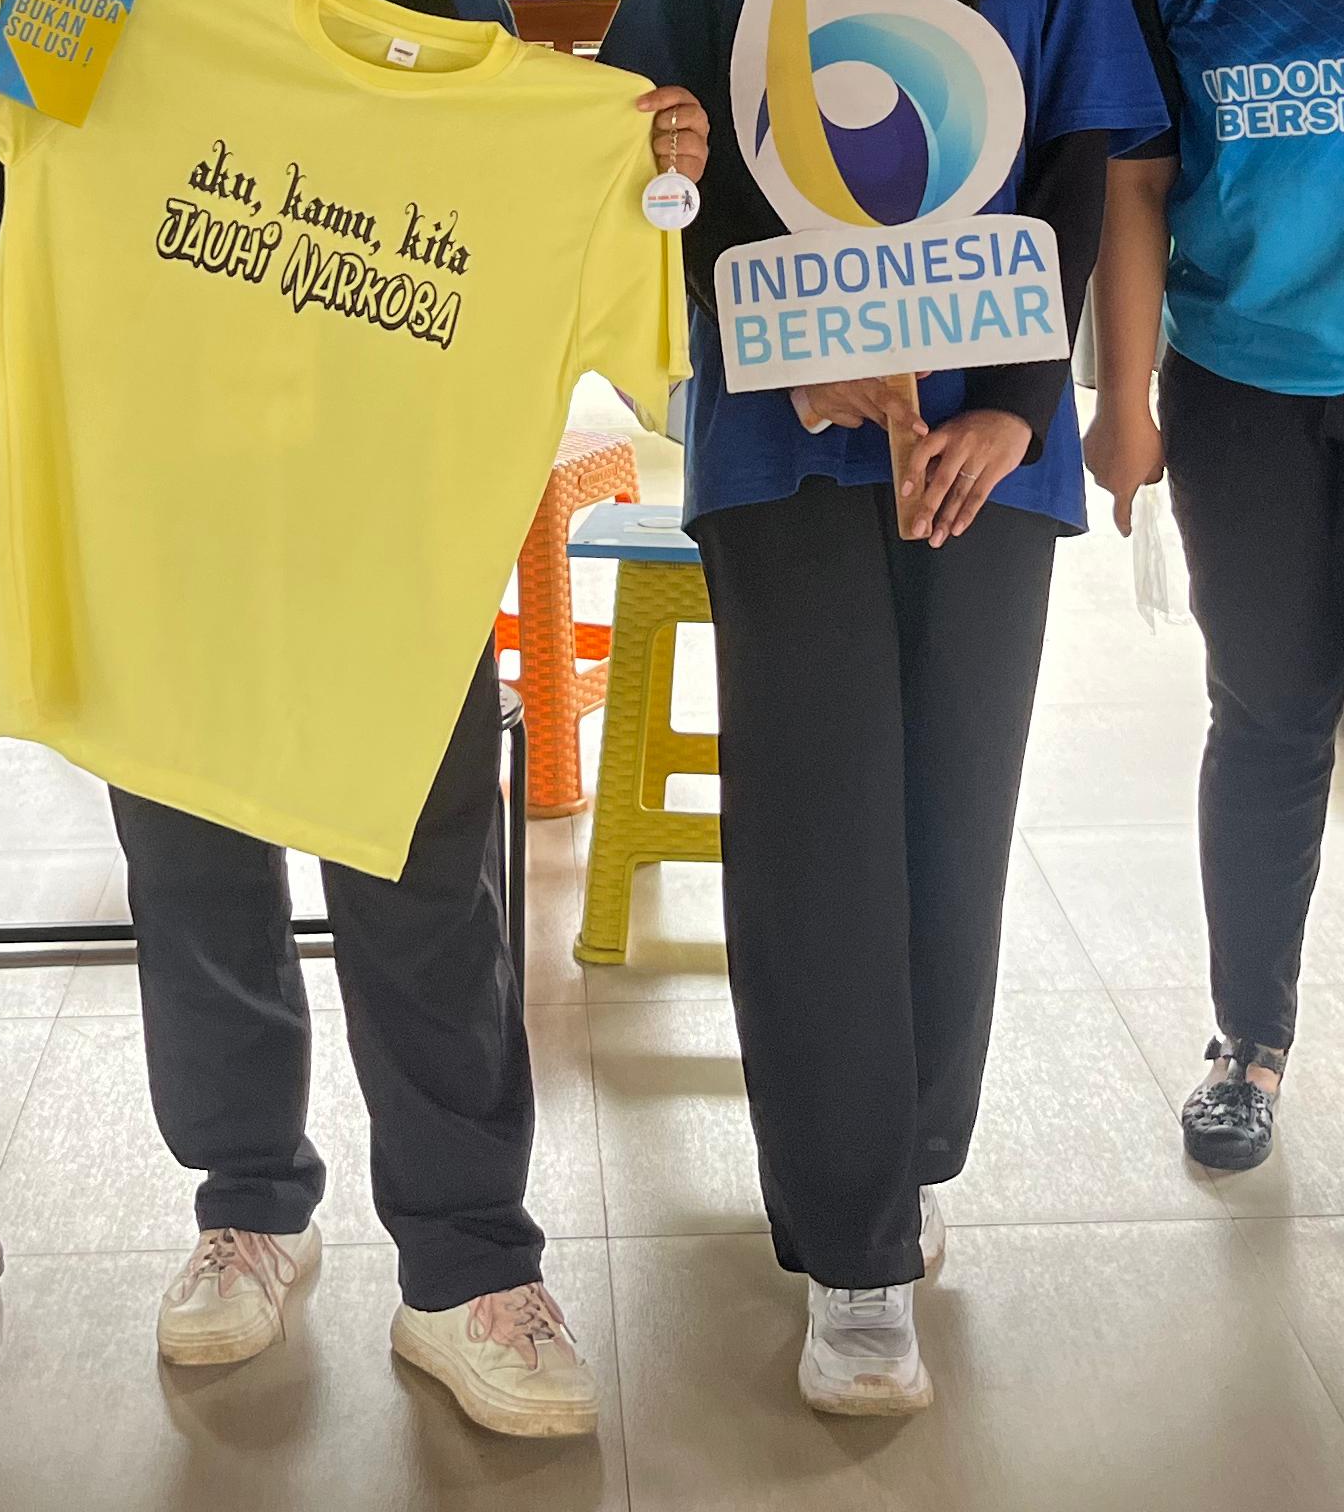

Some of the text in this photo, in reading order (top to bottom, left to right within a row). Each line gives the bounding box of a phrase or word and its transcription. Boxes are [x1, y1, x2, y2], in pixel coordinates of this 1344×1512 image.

[6, 16, 80, 62] SOLUSI
[188, 138, 473, 276] aku, kamu, kita
[282, 234, 462, 349] NARKOBA
[731, 228, 1047, 306] INDONESIA
[734, 284, 1055, 366] BERSINAR
